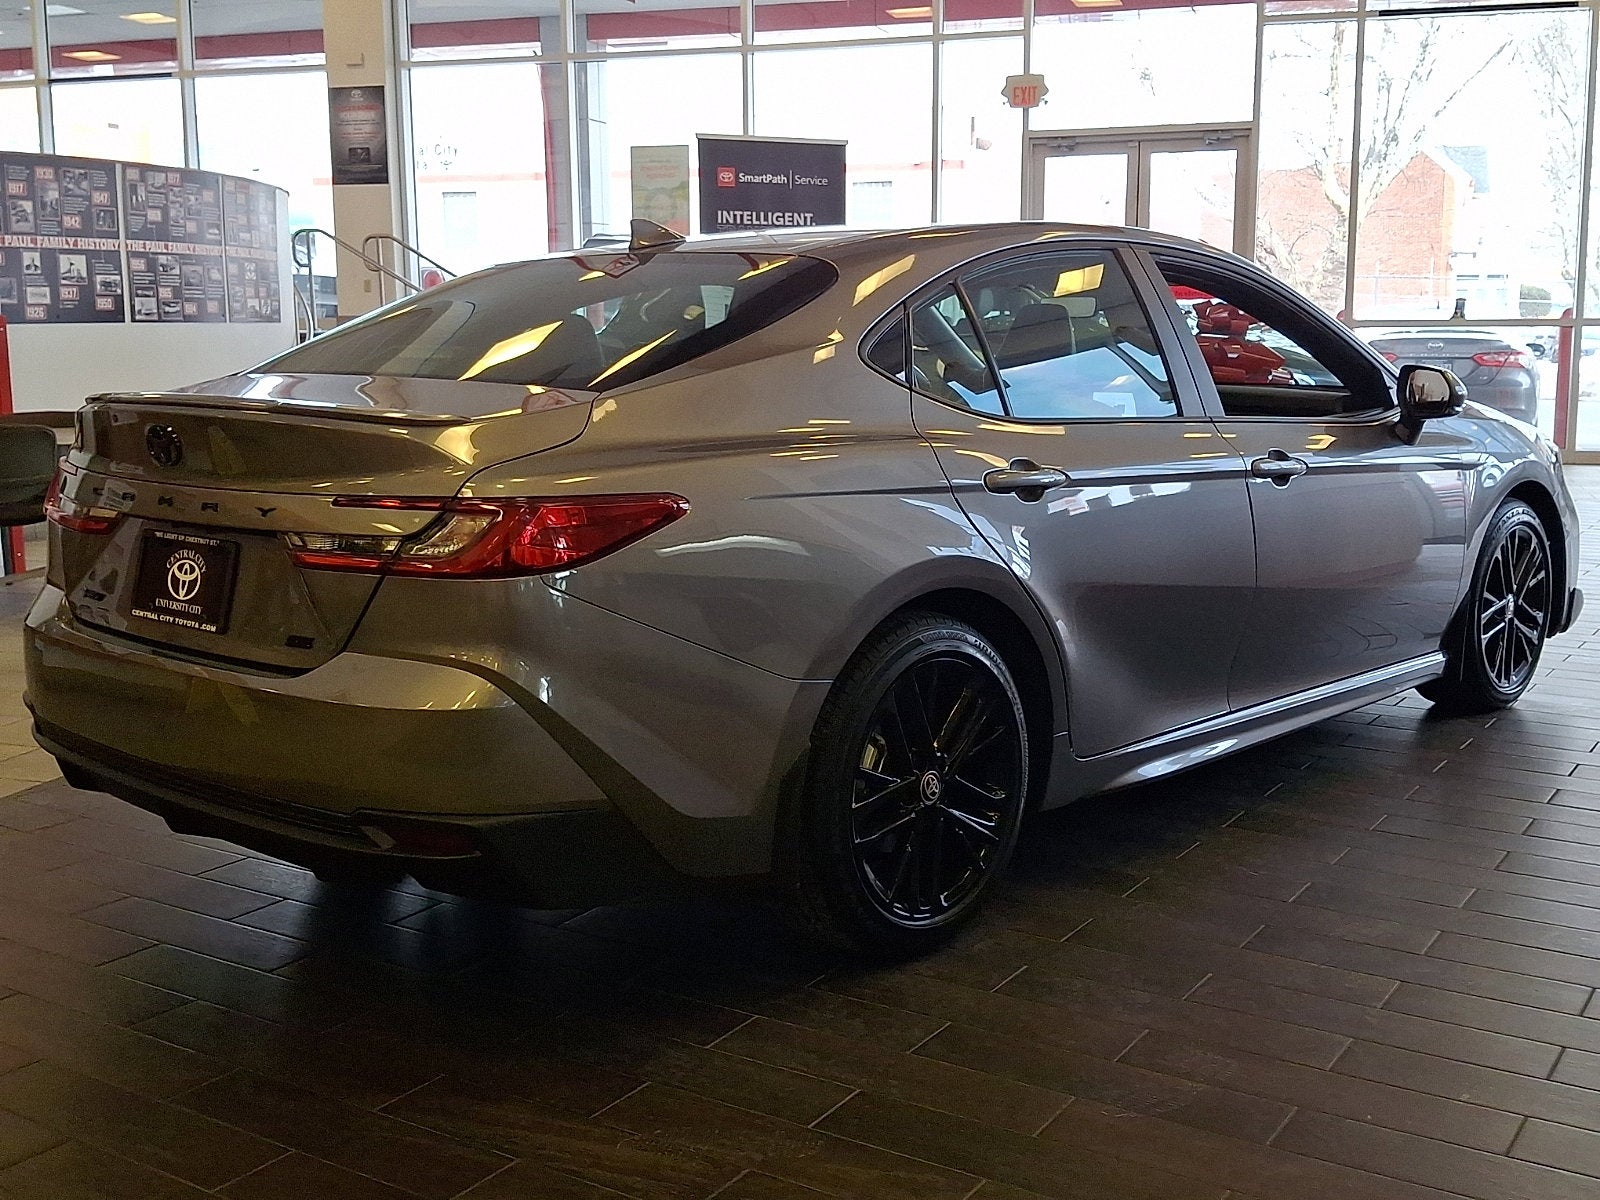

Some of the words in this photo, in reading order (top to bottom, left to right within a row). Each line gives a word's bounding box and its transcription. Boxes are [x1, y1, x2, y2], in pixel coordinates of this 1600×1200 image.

[1013, 86, 1038, 106] EXIT
[738, 172, 788, 185] SmartPath
[794, 175, 829, 186] Service
[717, 210, 816, 227] INTELLIGENT.
[5, 236, 34, 248] PAUL
[37, 237, 75, 249] FAMILY
[77, 238, 121, 250] HISTORY
[126, 240, 145, 251] THE
[145, 242, 165, 252] PAUL
[166, 549, 196, 569] CENTRAL
[195, 553, 207, 573] CITY
[155, 598, 189, 613] UNIVERSITY
[189, 604, 204, 616] CITY
[131, 609, 159, 621] CENTRAL
[159, 614, 174, 624] CITY
[175, 617, 199, 629] TOYOTA
